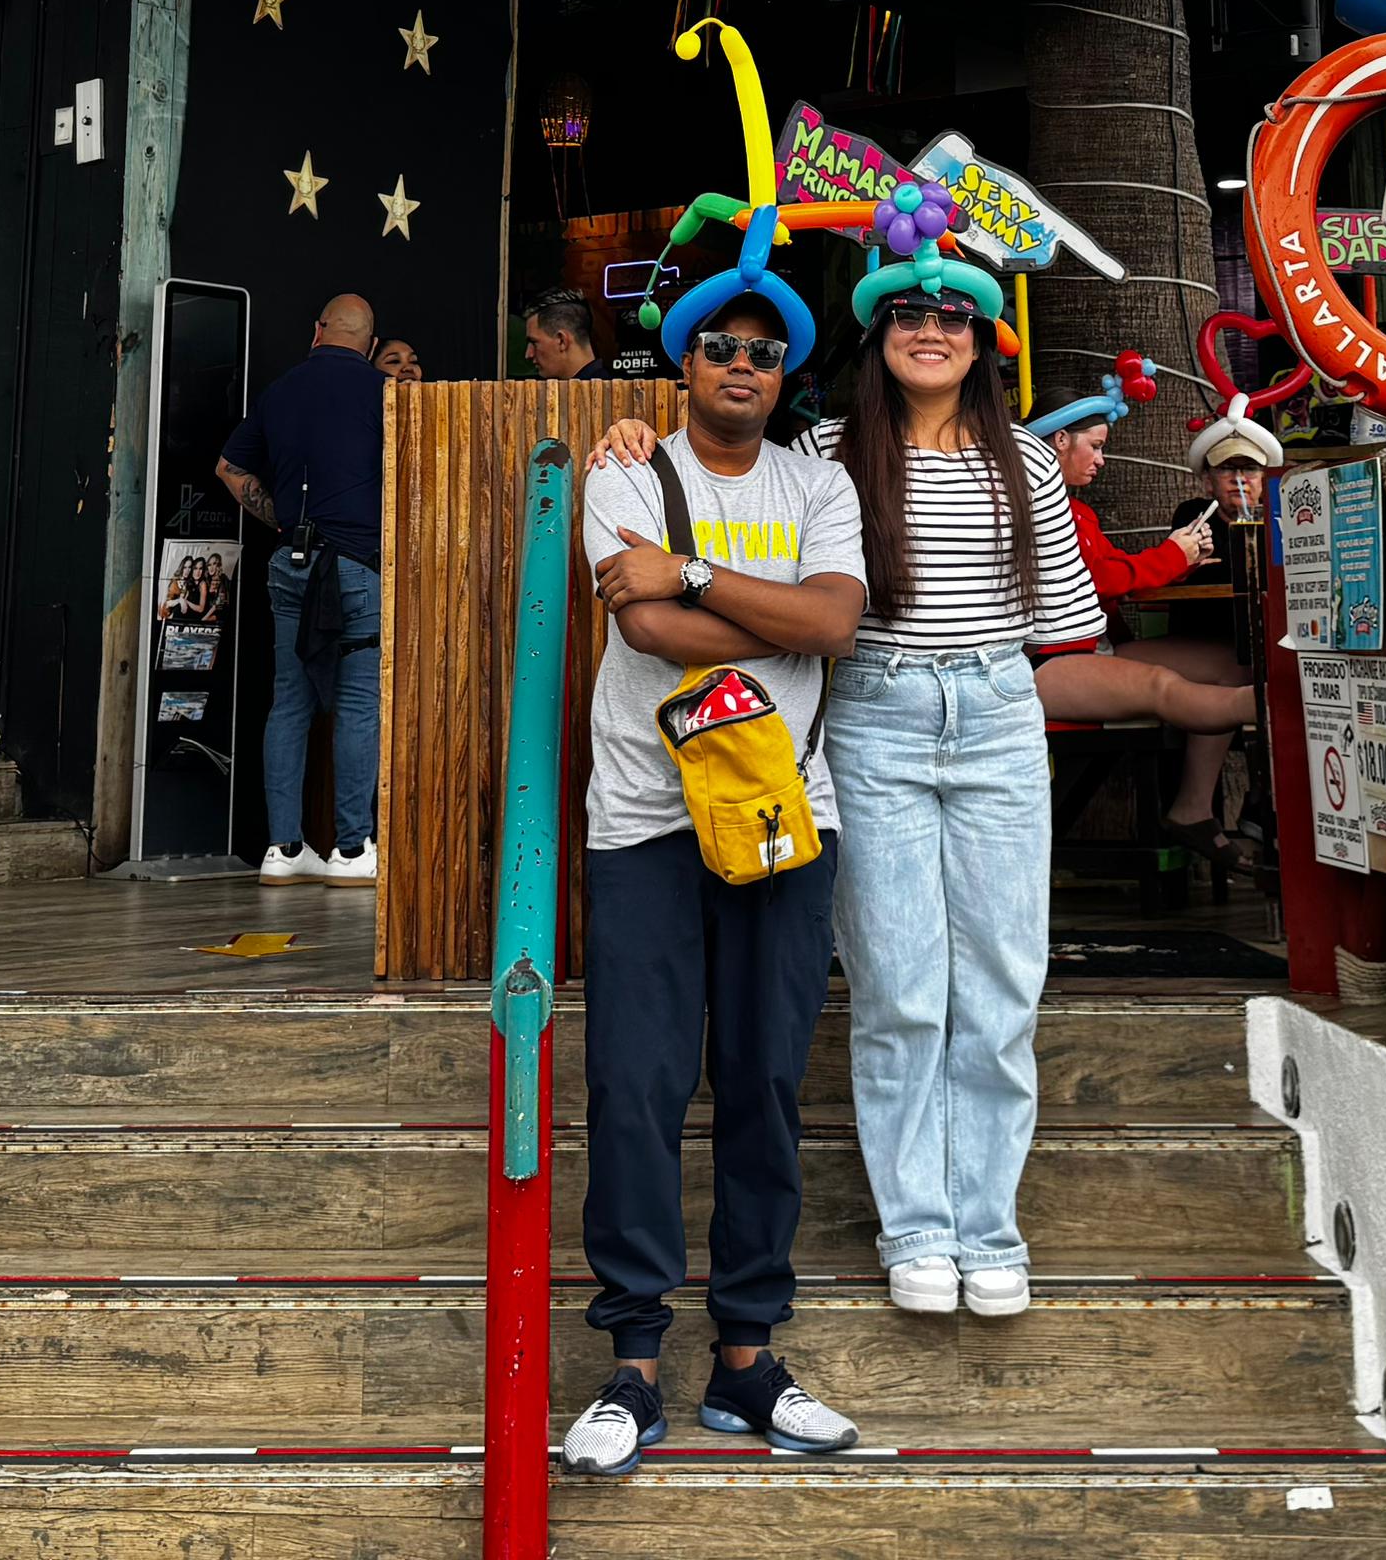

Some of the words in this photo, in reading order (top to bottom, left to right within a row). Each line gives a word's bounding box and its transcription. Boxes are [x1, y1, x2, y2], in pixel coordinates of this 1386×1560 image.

[791, 121, 898, 201] MAMAS
[957, 162, 1040, 223] SEXY
[612, 357, 659, 370] DOBEL
[1297, 621, 1310, 638] VISA
[1303, 660, 1346, 680] PROHIBIDO
[1312, 682, 1341, 701] FUMAR
